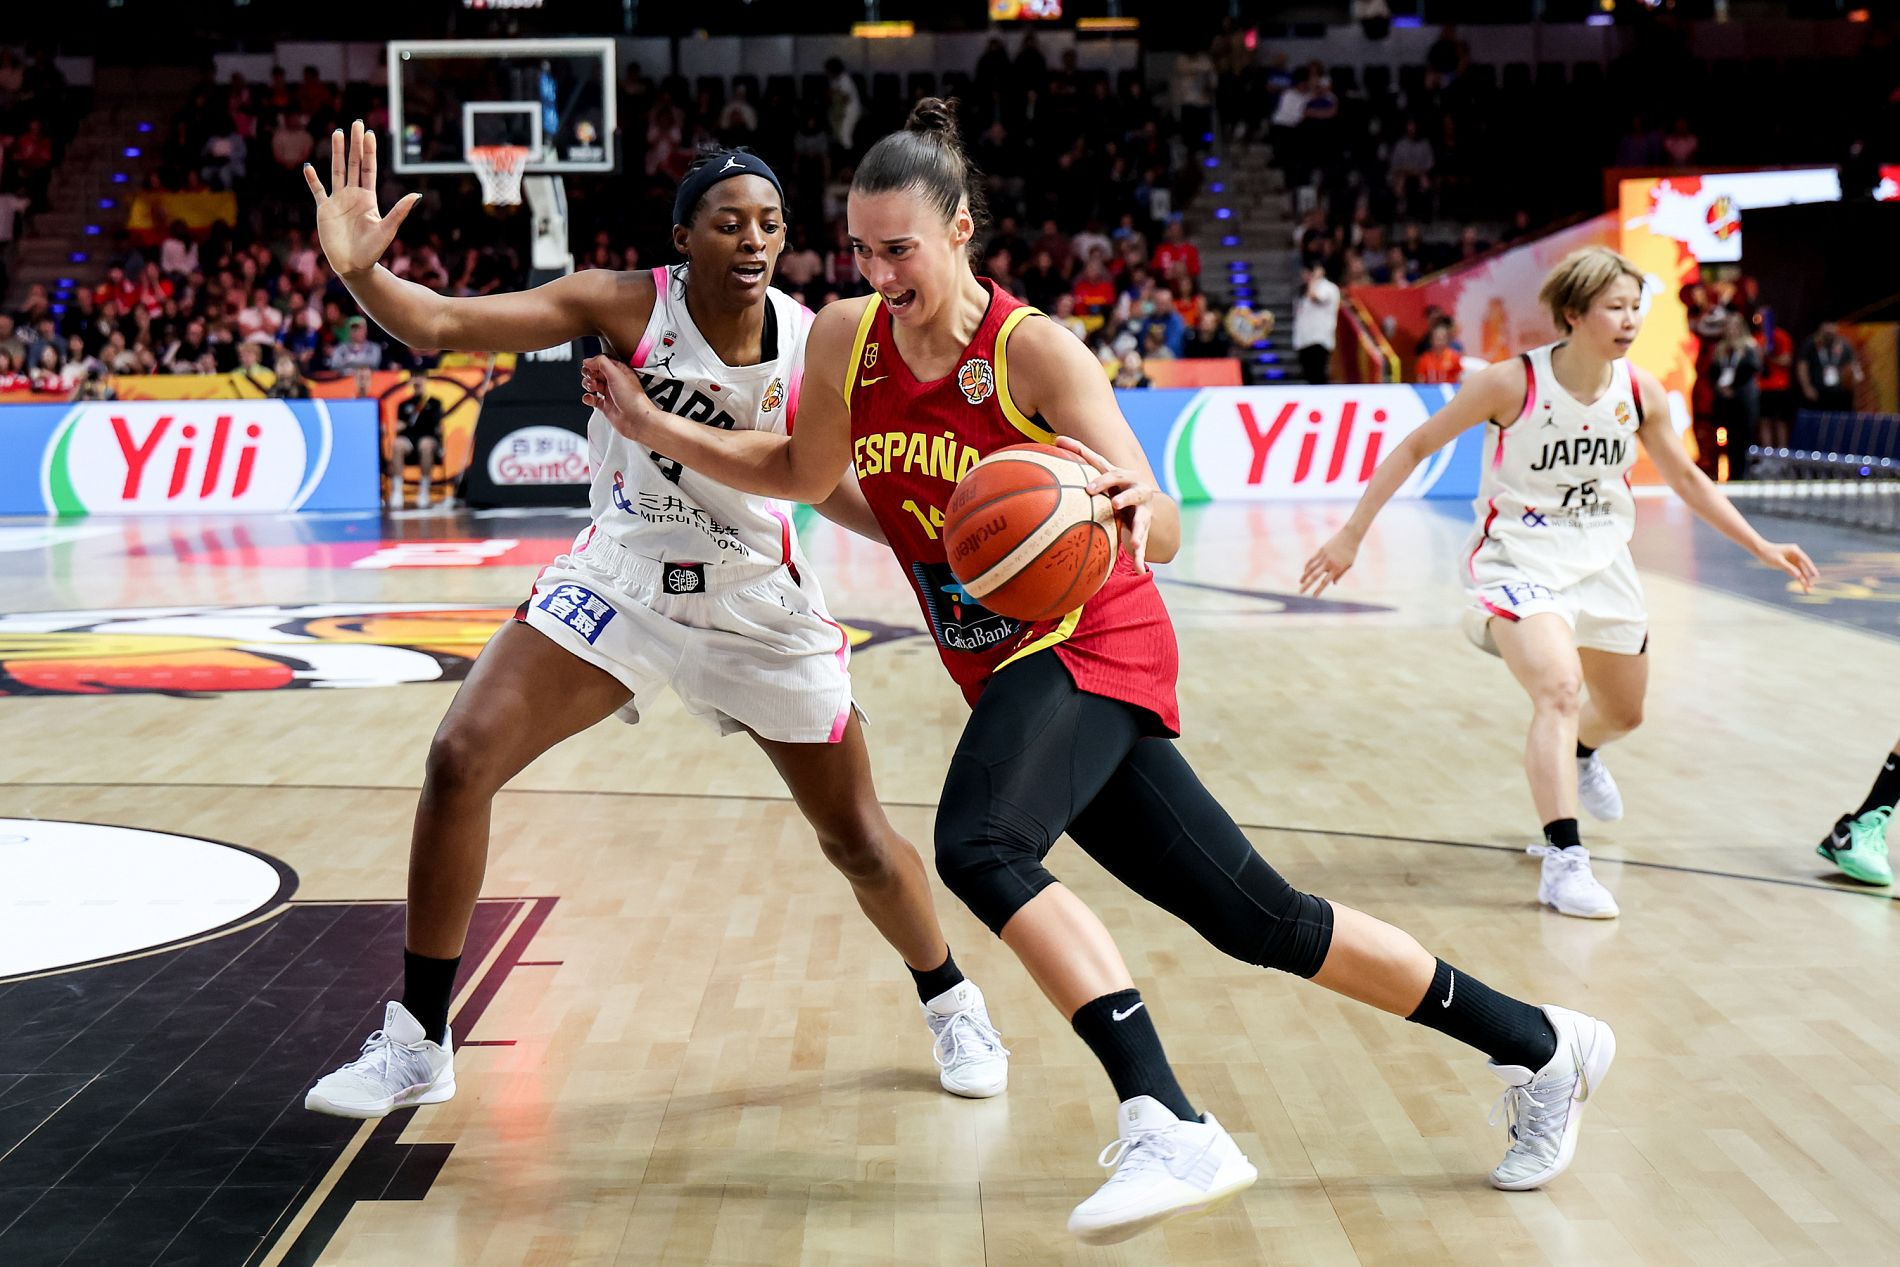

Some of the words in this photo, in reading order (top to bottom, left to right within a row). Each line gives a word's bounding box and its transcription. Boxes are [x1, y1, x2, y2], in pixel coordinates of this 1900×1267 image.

[110, 415, 261, 500] Yili
[1236, 401, 1387, 484] Yili
[1531, 438, 1626, 471] JAPAN
[1556, 478, 1598, 507] 75
[640, 509, 690, 525] MITSUI
[953, 514, 1008, 563] molten
